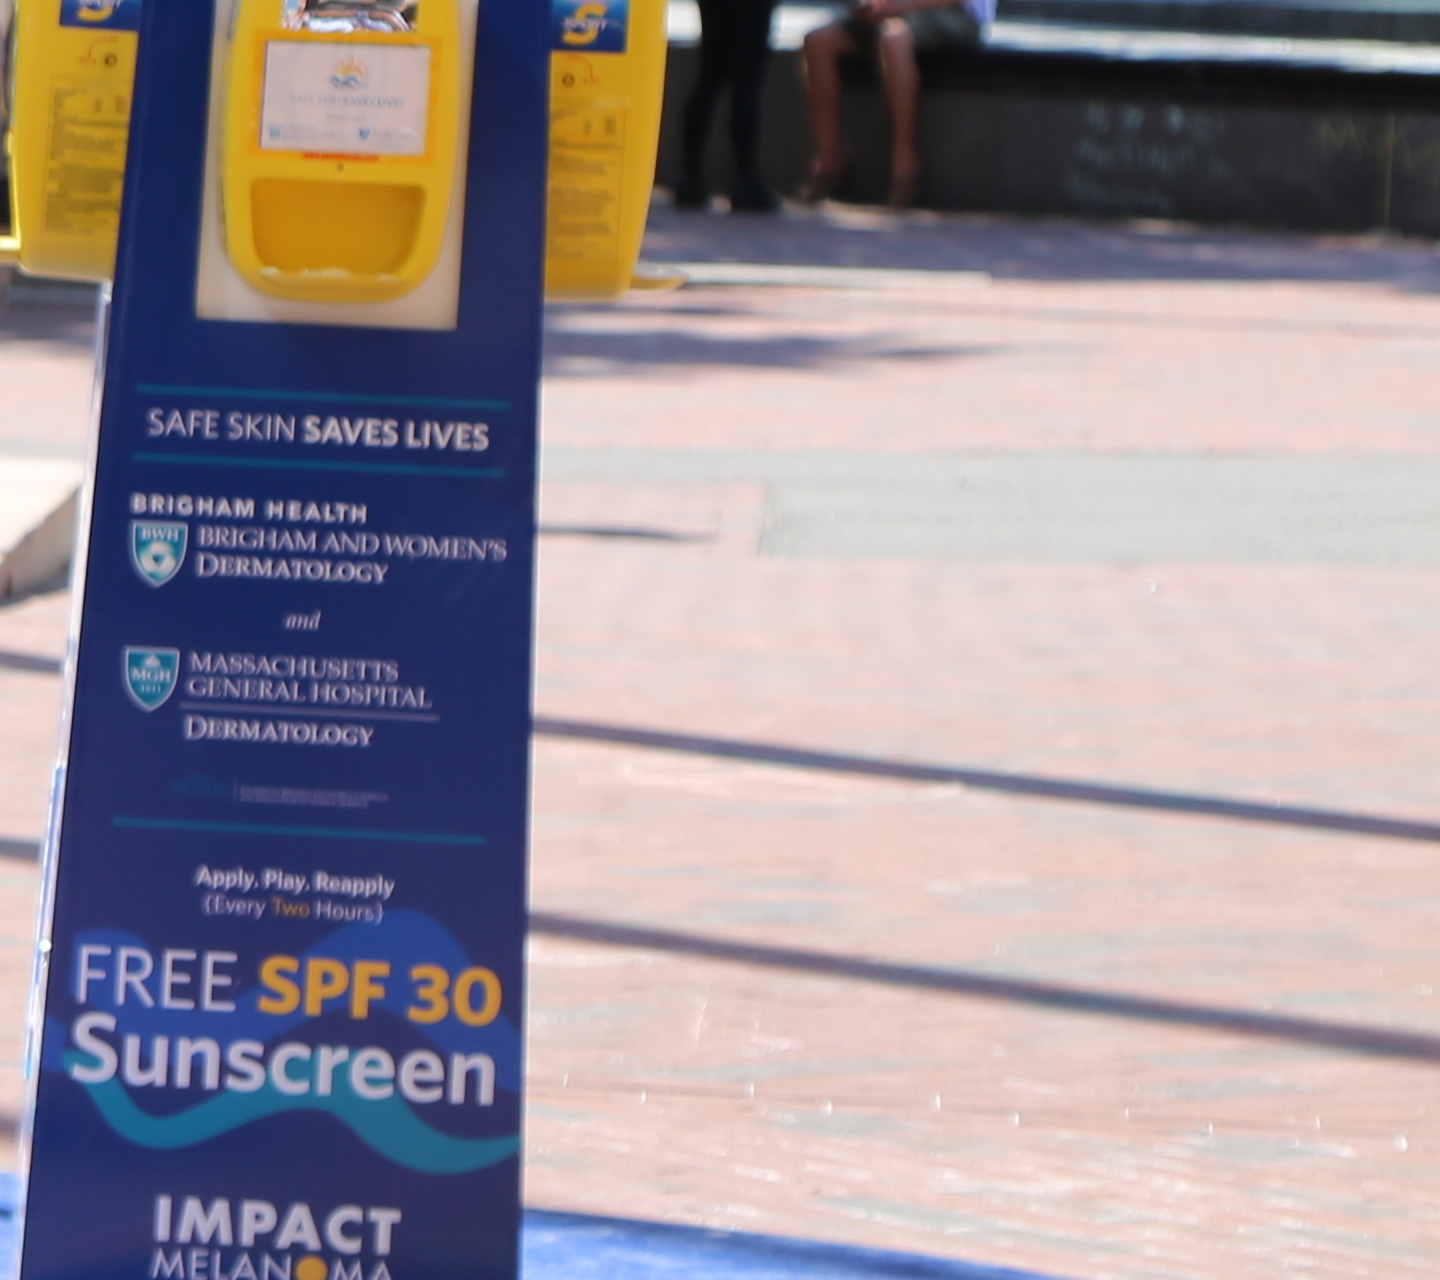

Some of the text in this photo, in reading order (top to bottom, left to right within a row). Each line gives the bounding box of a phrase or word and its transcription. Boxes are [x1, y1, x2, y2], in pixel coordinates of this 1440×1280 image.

[148, 408, 489, 451] SAFE SKIN SAVES LIVES
[131, 492, 367, 524] BRIGHAM HEALTH
[198, 525, 507, 562] BRIGHAM AND WOMEN'S
[285, 610, 320, 629] and
[189, 651, 398, 681] MASSACHUSETTS
[187, 679, 432, 708] GENERAL HOSPITAL
[315, 870, 395, 900] Reapply
[271, 896, 310, 918] Two
[77, 944, 503, 1027] FREE SPF 30
[70, 1012, 496, 1107] Sunscreen
[153, 1194, 402, 1256] IMPACT
